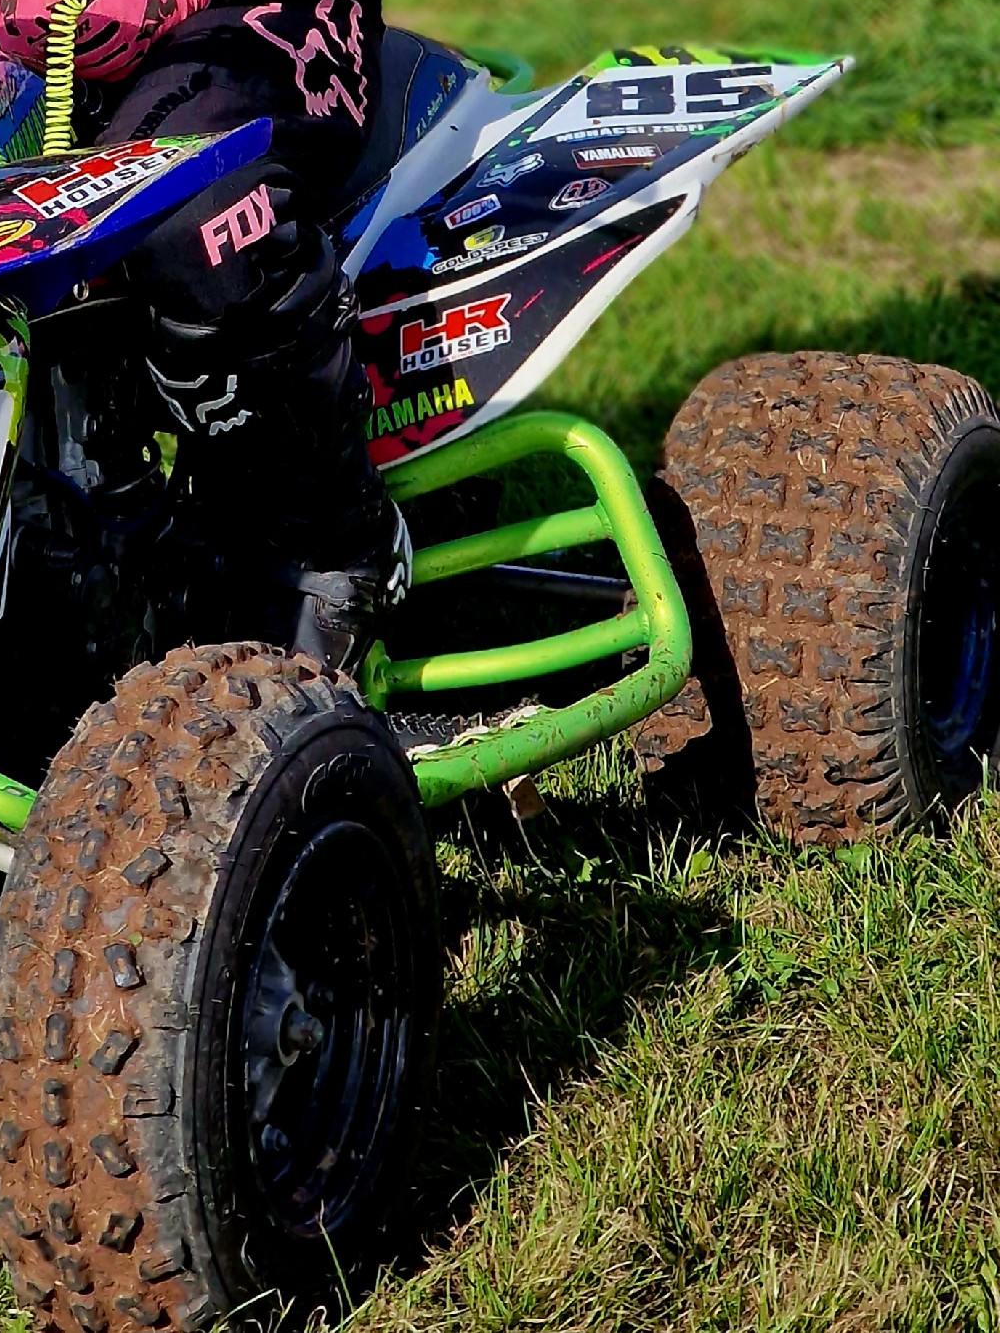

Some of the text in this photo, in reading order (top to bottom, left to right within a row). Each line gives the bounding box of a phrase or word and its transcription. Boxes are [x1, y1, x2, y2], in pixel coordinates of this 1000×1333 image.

[587, 66, 775, 118] 85
[578, 146, 657, 162] YAMALUBE
[201, 184, 276, 267] FOX
[453, 198, 496, 223] 100%
[402, 328, 508, 372] HOUSER
[365, 378, 475, 440] YAMAHA
